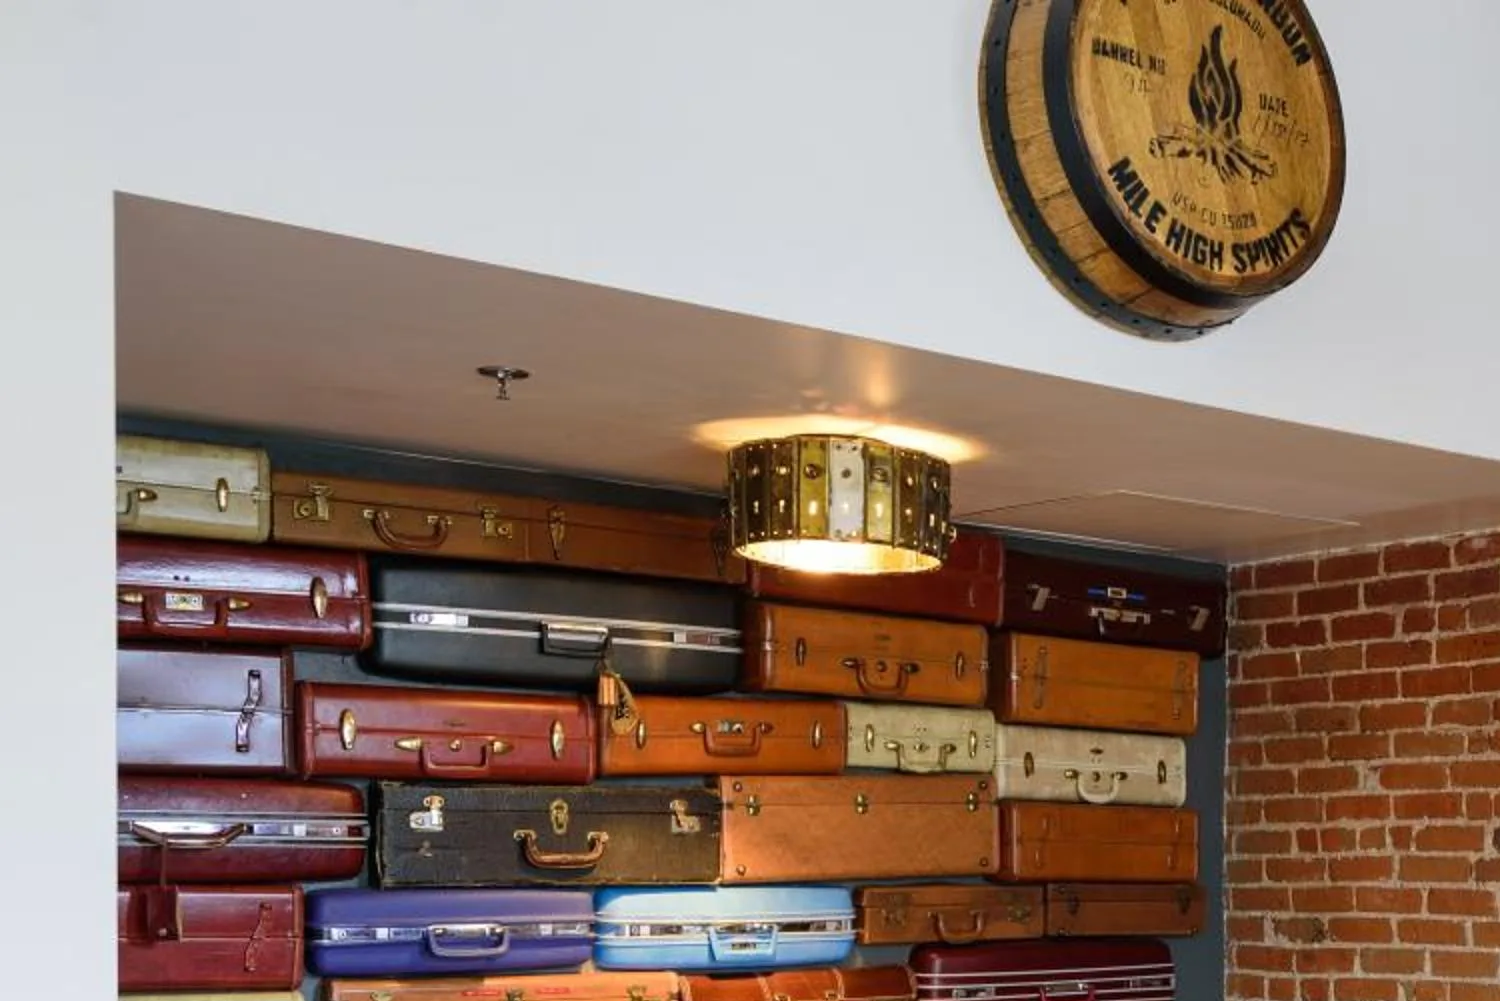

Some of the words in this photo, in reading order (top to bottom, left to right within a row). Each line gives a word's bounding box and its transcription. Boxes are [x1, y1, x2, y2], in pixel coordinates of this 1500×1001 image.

[1092, 36, 1143, 69] BARREL
[1259, 93, 1289, 118] DATE
[1107, 156, 1167, 234] MILE
[1165, 217, 1225, 273] HIGH
[1231, 207, 1312, 274] SPIRITS
